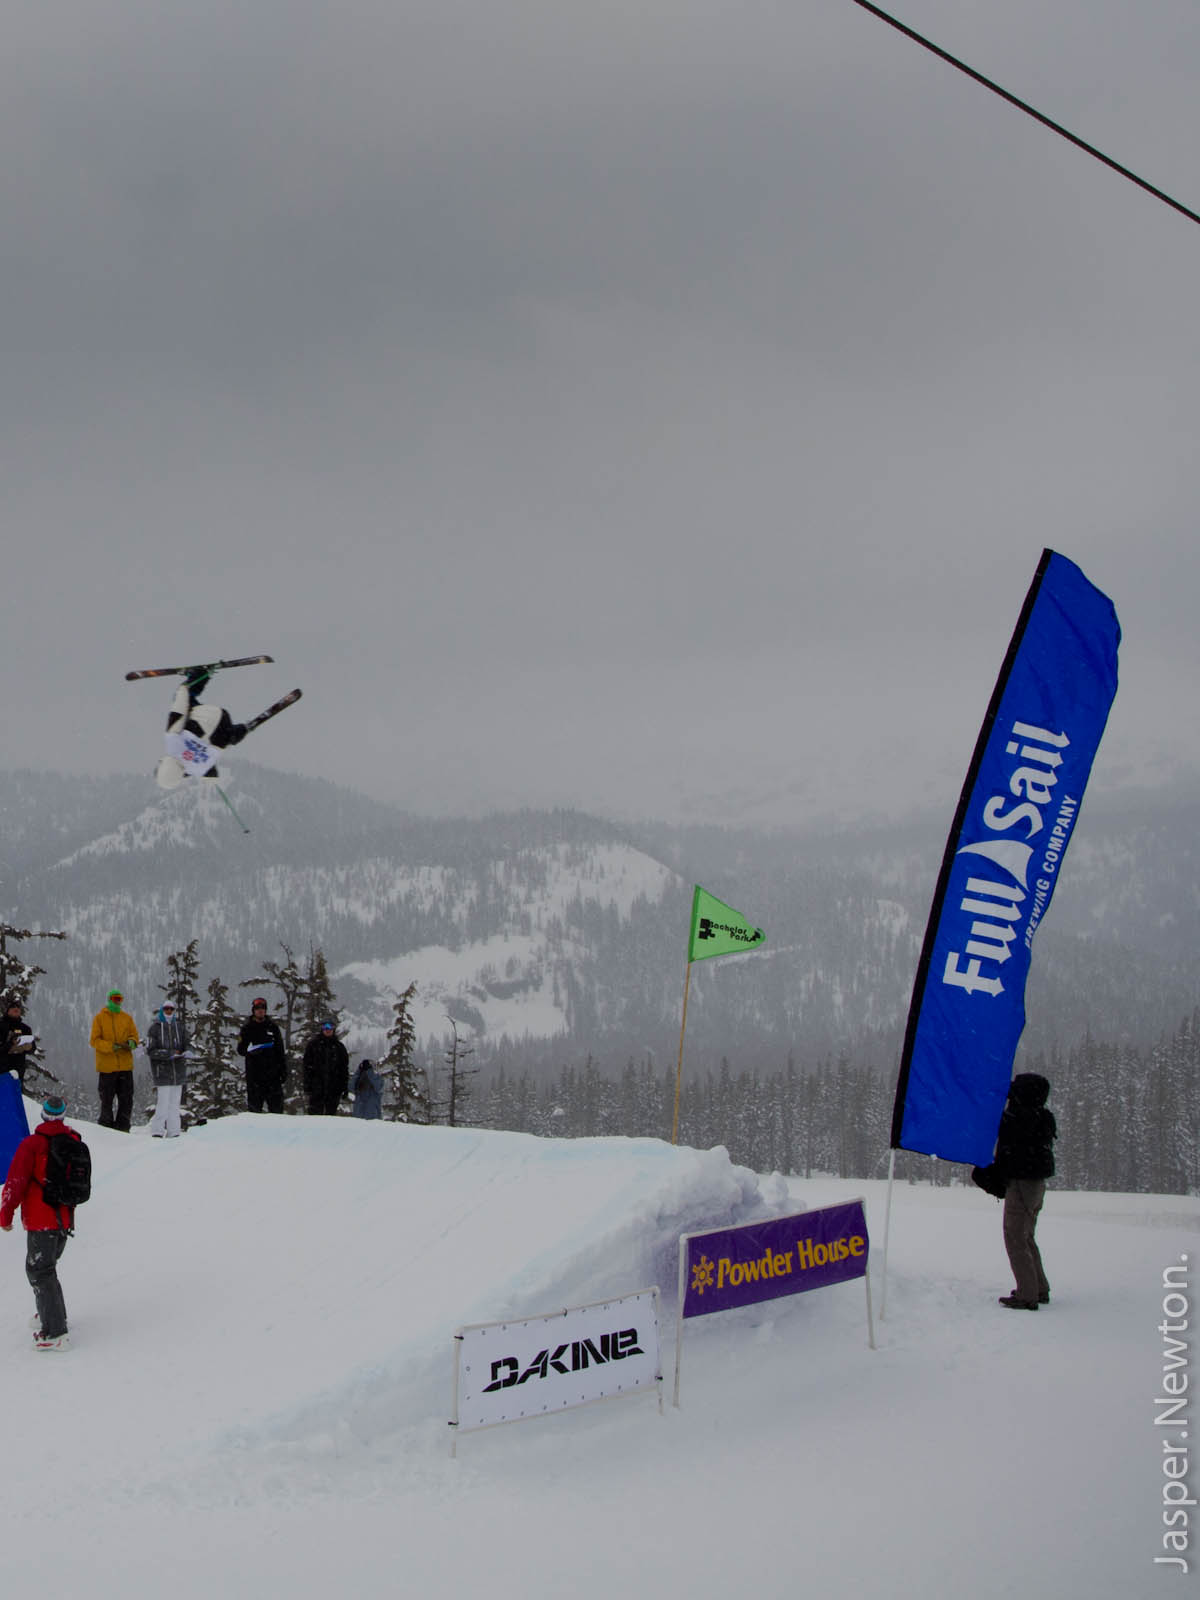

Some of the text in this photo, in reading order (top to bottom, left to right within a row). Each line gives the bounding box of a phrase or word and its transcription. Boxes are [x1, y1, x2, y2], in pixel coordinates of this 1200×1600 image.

[943, 721, 1071, 997] Full Sail
[1042, 795, 1078, 873] COMPANY
[710, 921, 747, 935] Bachelor
[717, 1235, 865, 1289] Powder House
[482, 1328, 646, 1392] DAKINE
